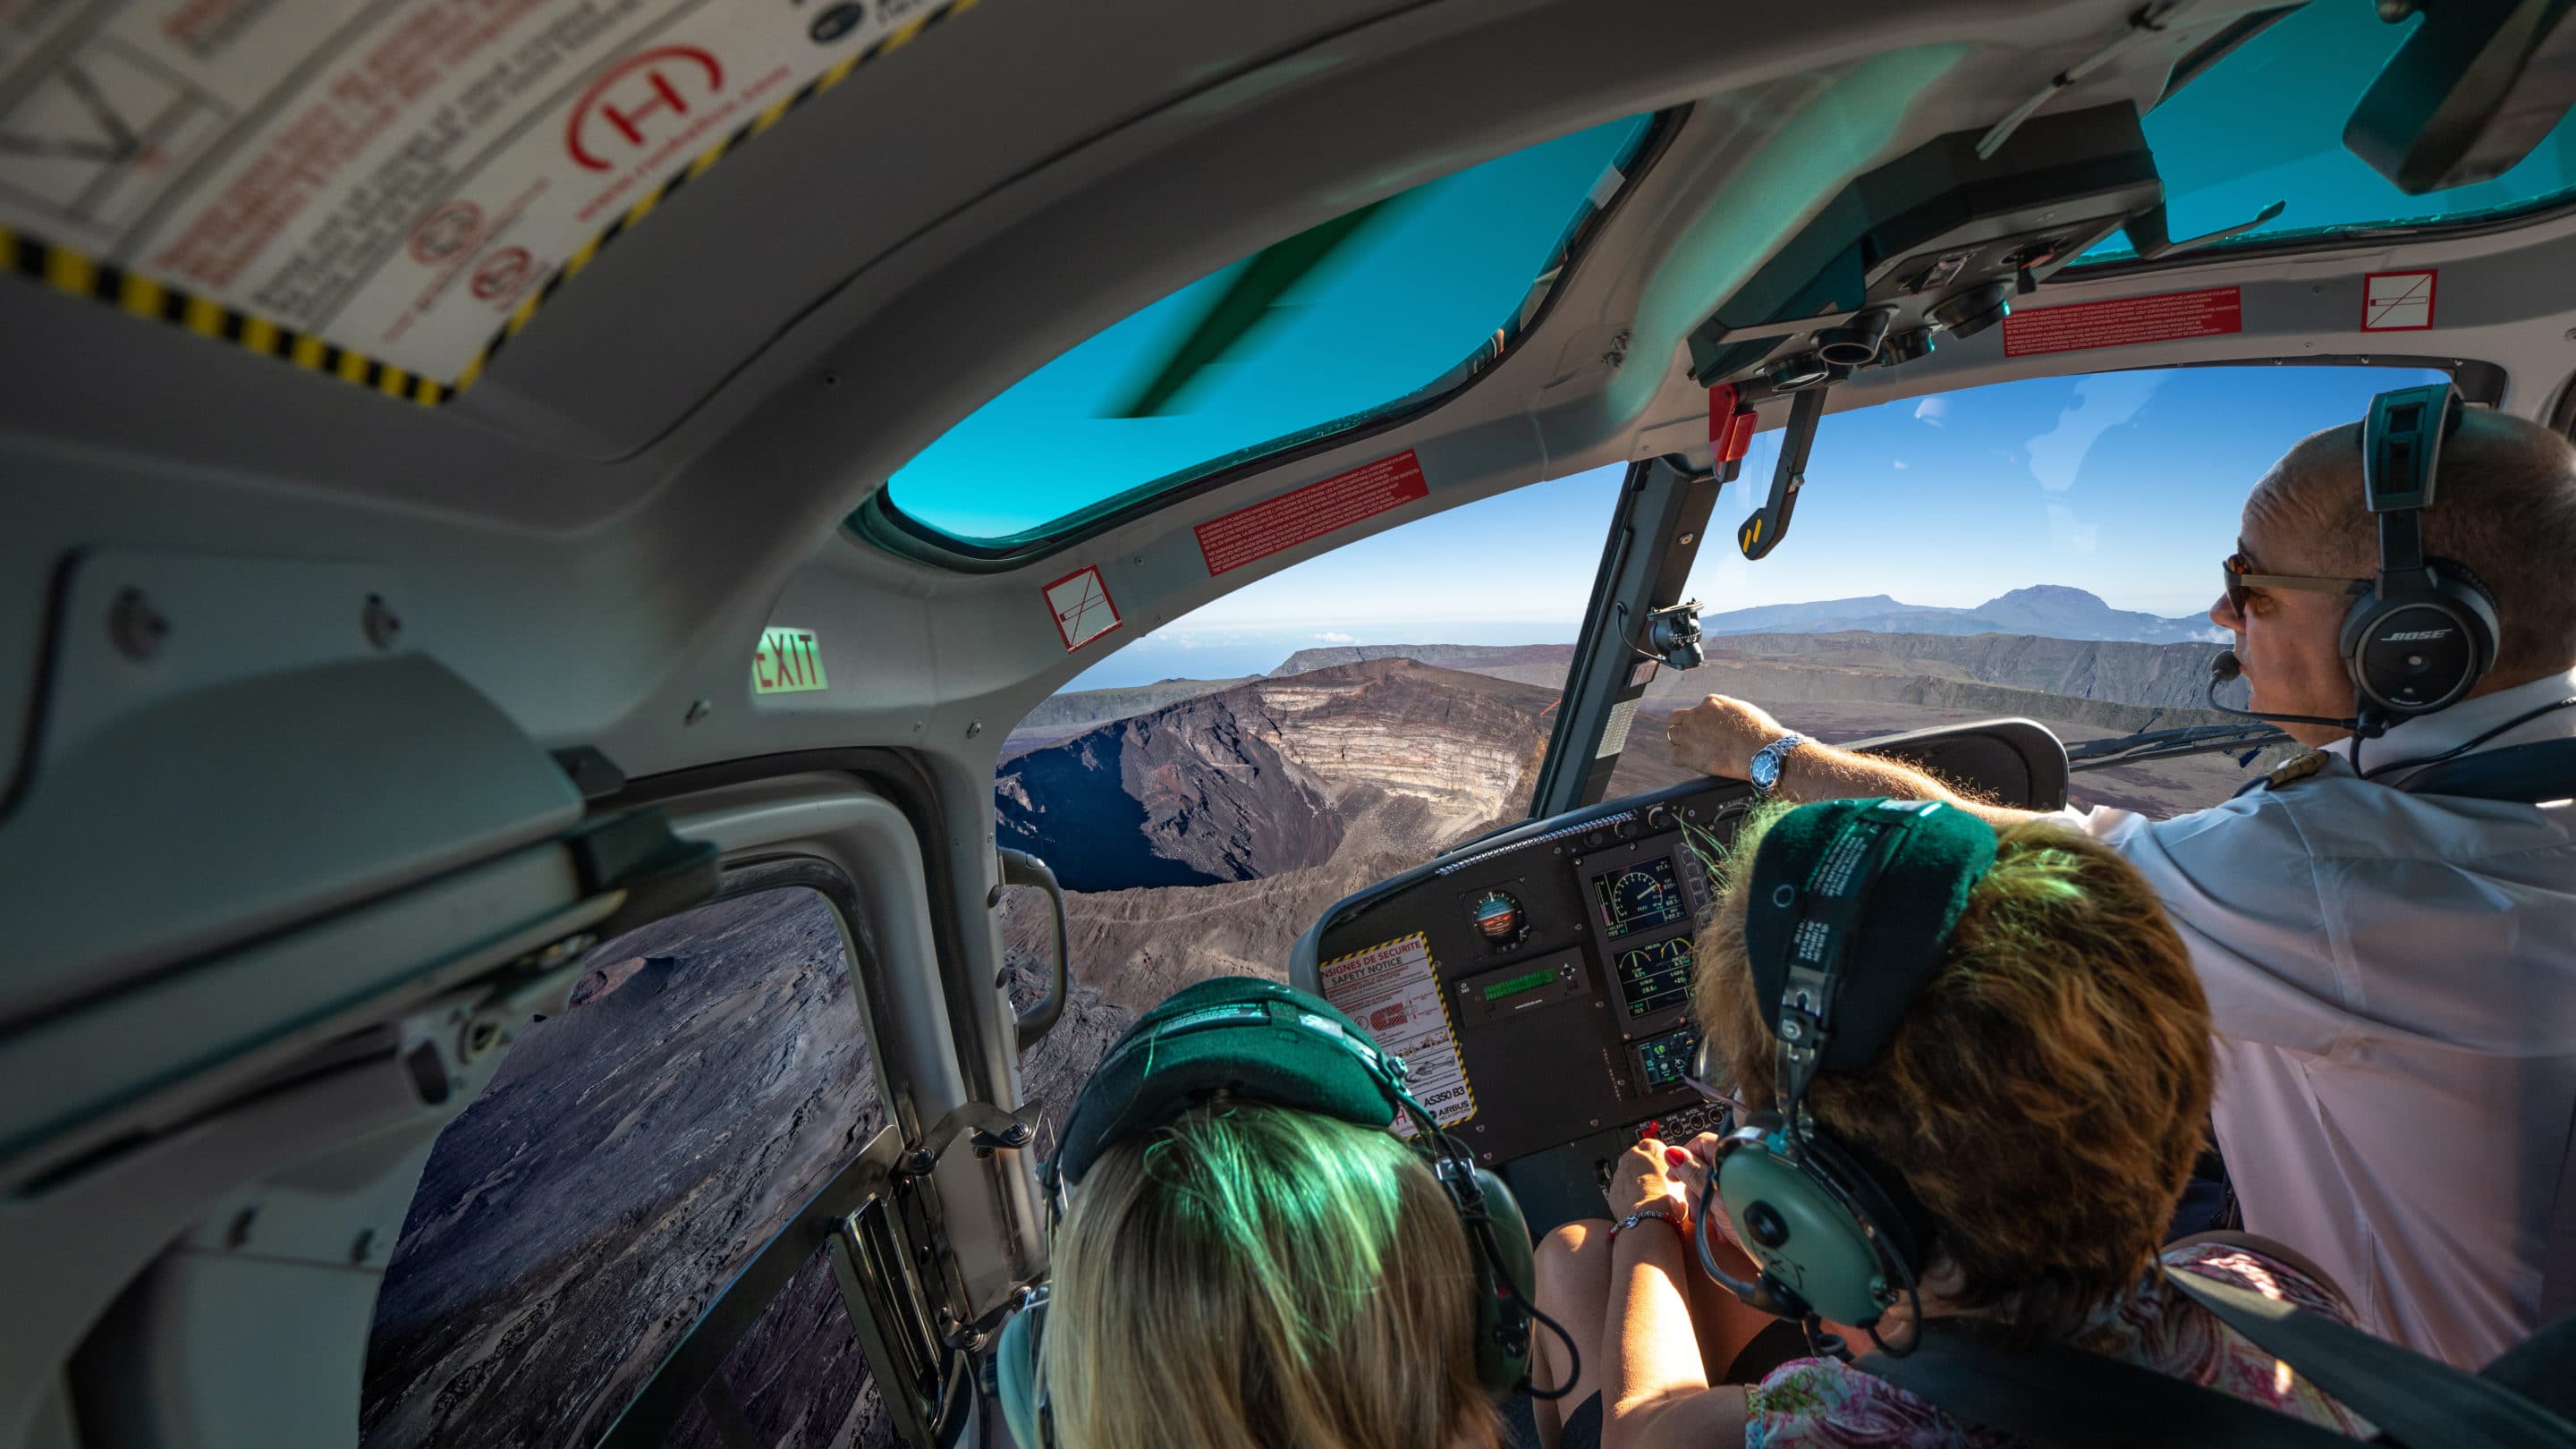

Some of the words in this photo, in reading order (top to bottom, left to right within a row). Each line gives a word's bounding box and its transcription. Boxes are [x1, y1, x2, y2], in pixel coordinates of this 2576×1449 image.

[2384, 629, 2449, 641] BOSE
[1363, 953, 1377, 965] DE
[1378, 940, 1421, 961] SECURITE
[1332, 969, 1366, 985] SAFETY
[1368, 956, 1403, 974] NOTICE
[1424, 1091, 1453, 1107] AS350
[1453, 1086, 1465, 1097] B3
[1438, 1100, 1469, 1117] AIRBUS
